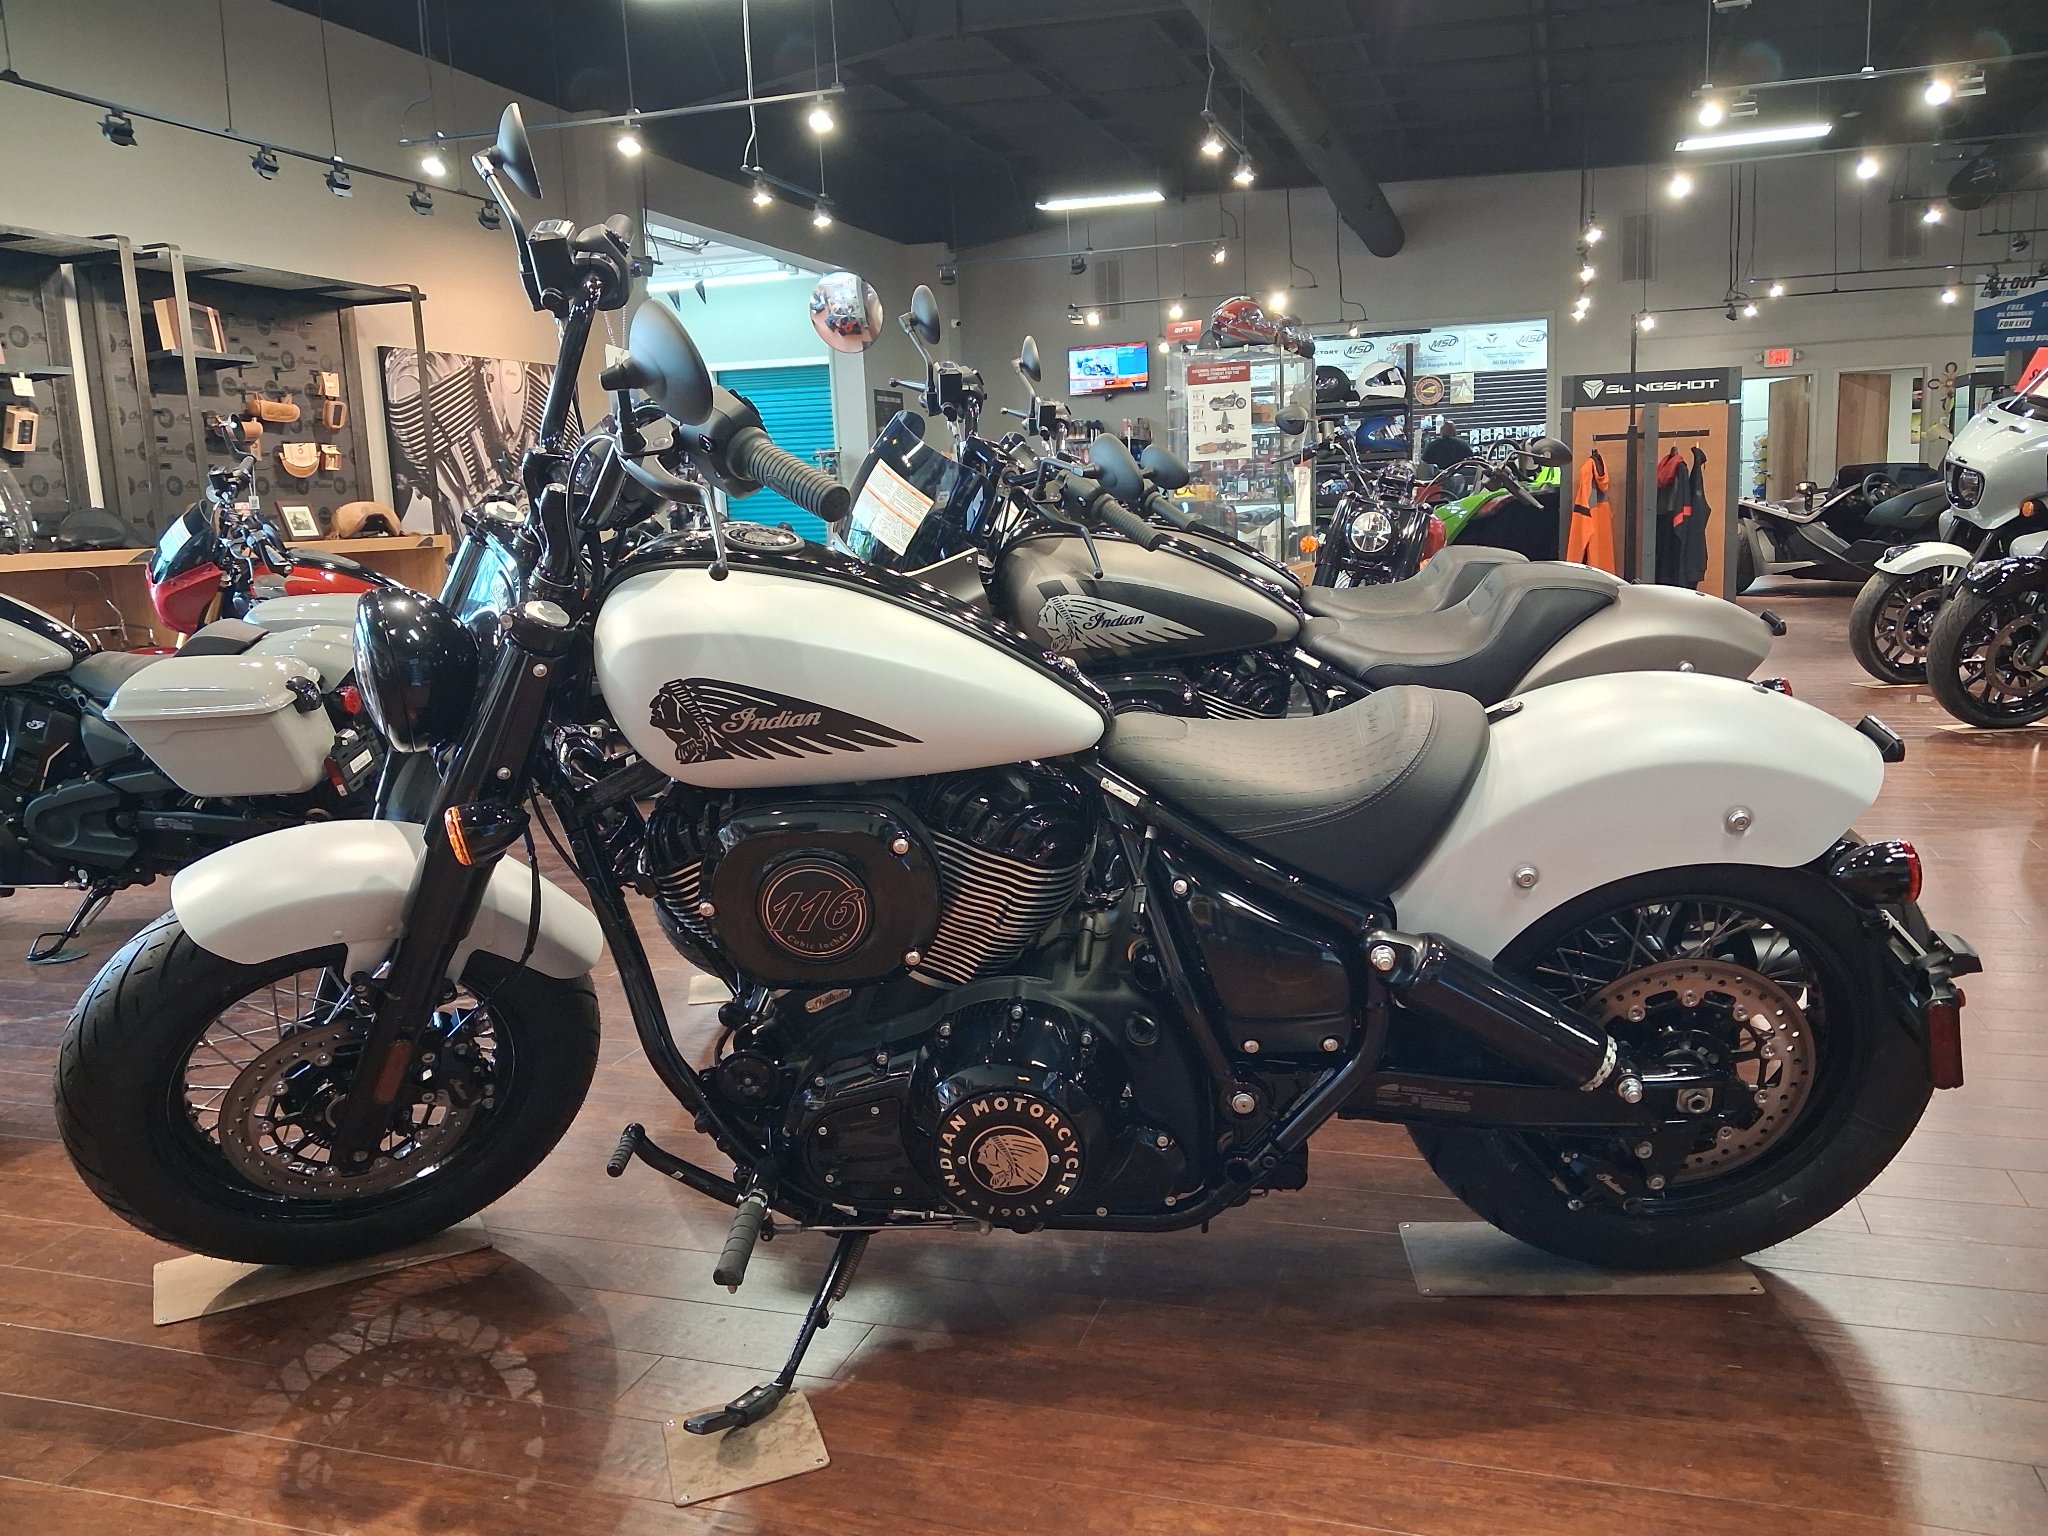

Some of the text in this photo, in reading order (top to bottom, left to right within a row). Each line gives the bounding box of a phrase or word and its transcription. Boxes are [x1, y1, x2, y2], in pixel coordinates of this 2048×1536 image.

[2000, 320, 2013, 328] FOR
[1346, 345, 1372, 355] MSD
[1431, 339, 1457, 348] MSD
[1605, 379, 1720, 394] SLNGSHOT
[1082, 612, 1145, 630] Indian
[720, 707, 822, 733] Indian
[770, 887, 866, 932] 116
[787, 931, 848, 950] Cubic Inches
[939, 1097, 1079, 1197] INDIAN MOTORCYCLE
